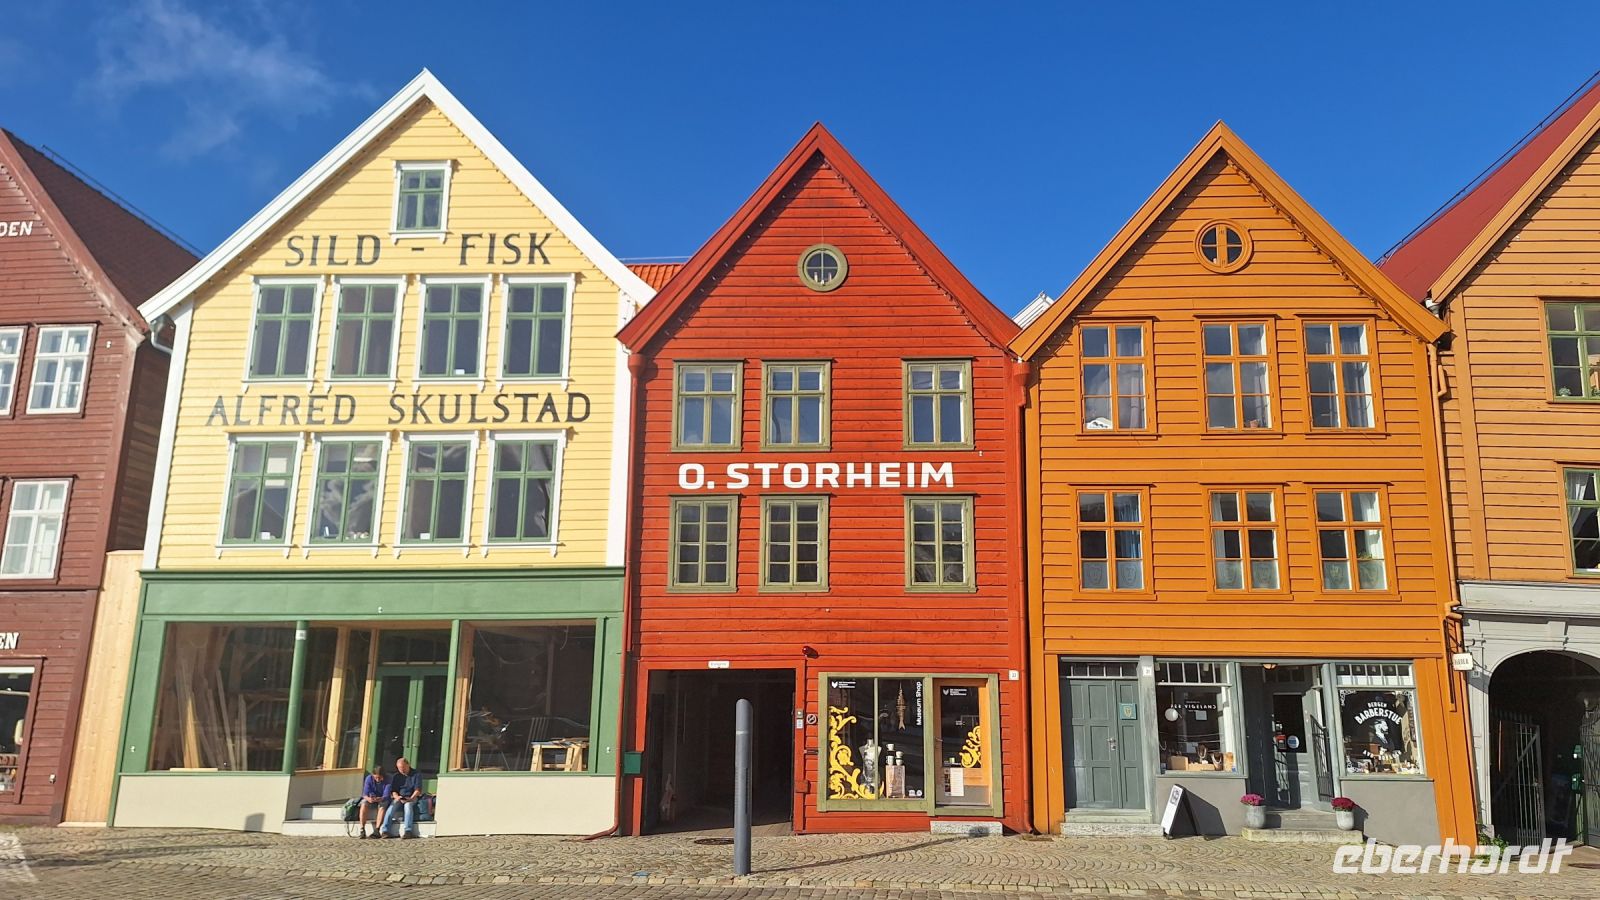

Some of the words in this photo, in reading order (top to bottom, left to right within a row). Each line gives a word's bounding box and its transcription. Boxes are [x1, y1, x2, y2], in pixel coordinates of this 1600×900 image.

[284, 234, 382, 267] SILD
[459, 232, 553, 266] FISK
[205, 394, 357, 426] ALFRED
[388, 392, 592, 424] SKULSTAD
[678, 462, 715, 490] O.
[726, 462, 954, 489] STORHEIM
[915, 681, 923, 698] Shop
